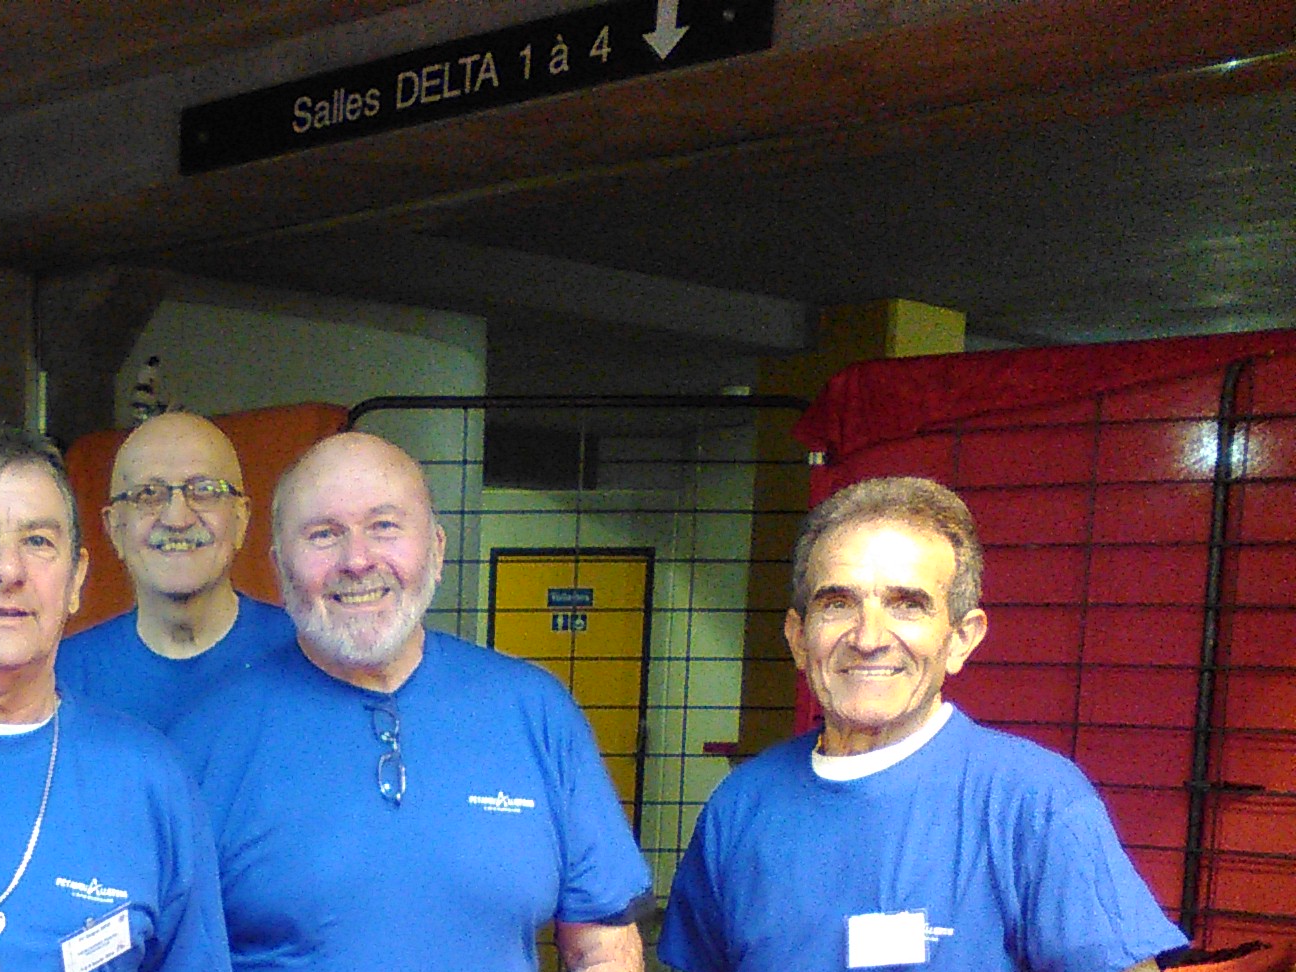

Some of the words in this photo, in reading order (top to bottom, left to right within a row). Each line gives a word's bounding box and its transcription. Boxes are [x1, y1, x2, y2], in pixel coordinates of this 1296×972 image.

[292, 87, 381, 133] Salles
[396, 51, 499, 110] DELTA
[519, 43, 532, 80] 1
[549, 32, 569, 75] à
[589, 24, 612, 62] 4
